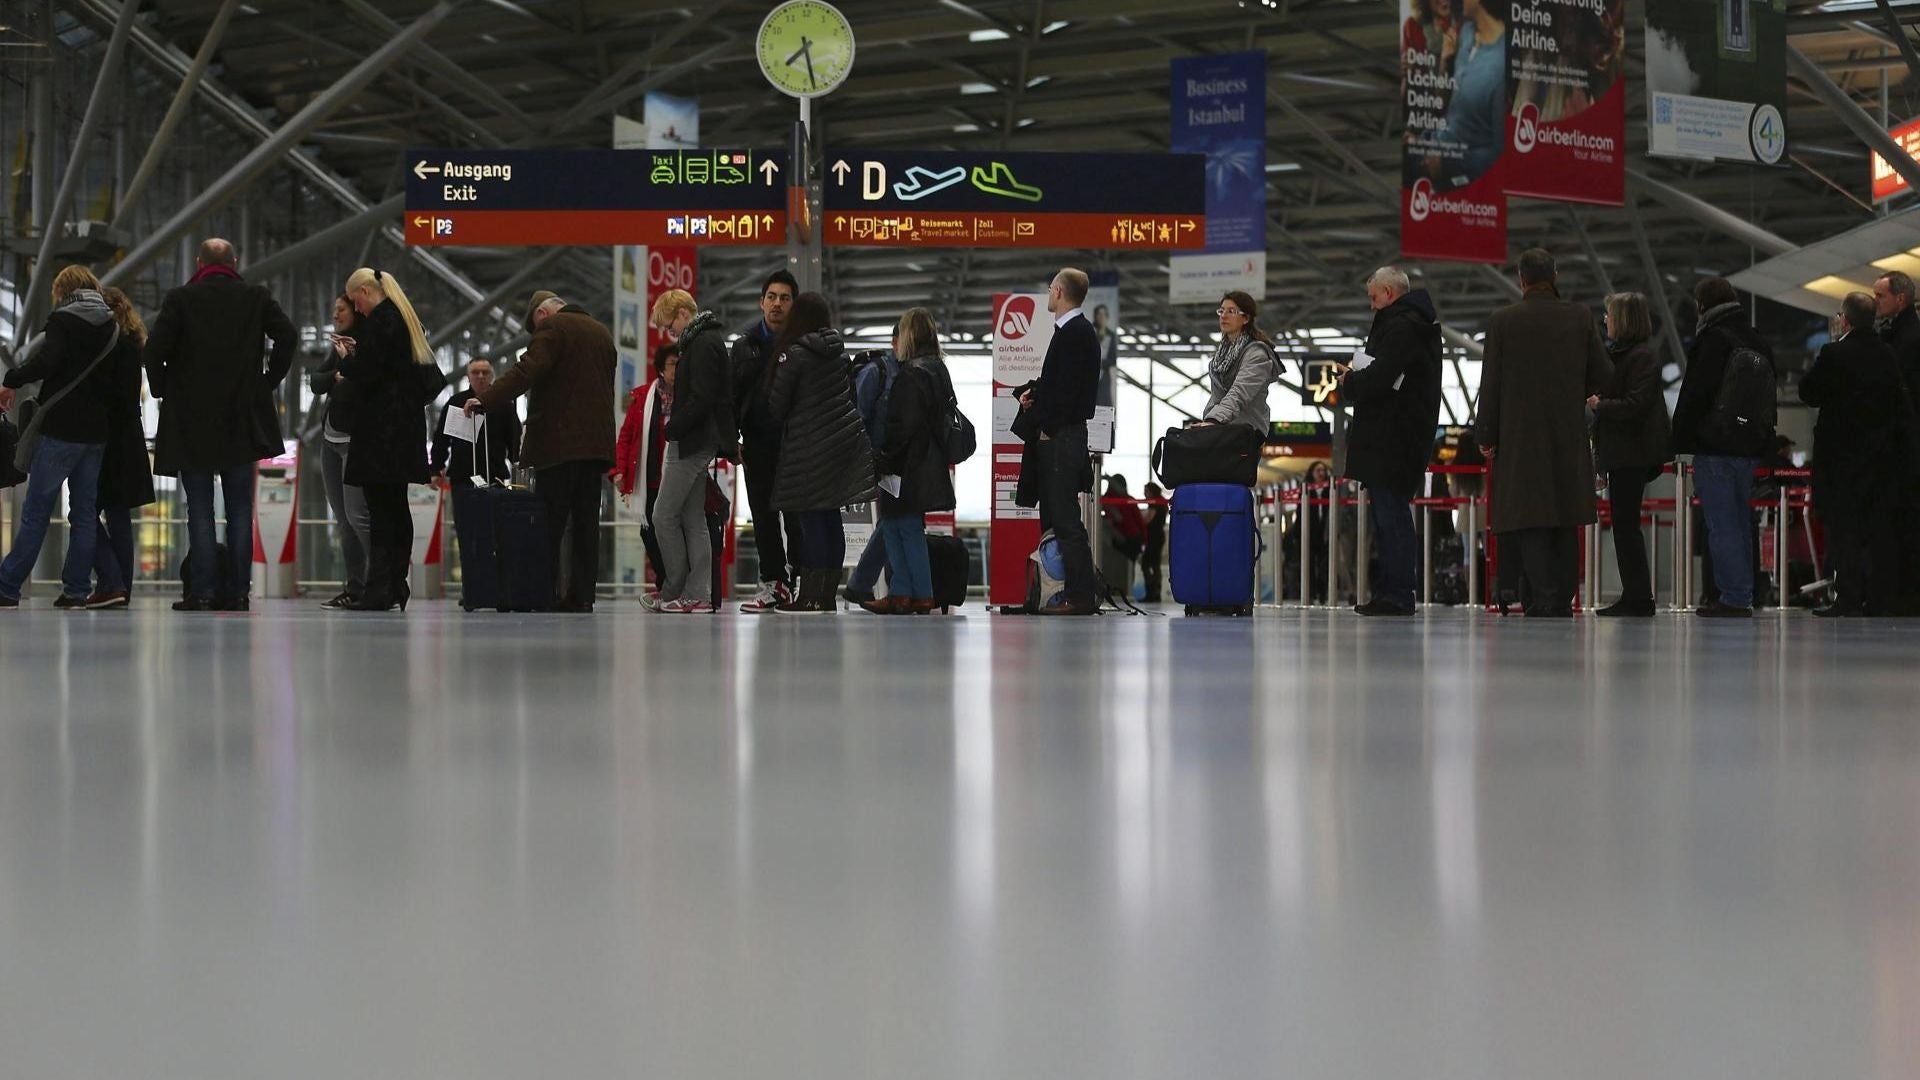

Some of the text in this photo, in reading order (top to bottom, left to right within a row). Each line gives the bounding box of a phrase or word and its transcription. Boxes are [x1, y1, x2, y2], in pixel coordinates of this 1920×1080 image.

[1511, 3, 1552, 27] Deine
[1511, 27, 1559, 53] Airline.
[1407, 47, 1436, 67] Dein
[1187, 78, 1248, 97] Business
[1407, 89, 1444, 110] Deine
[1188, 103, 1245, 126] Istanbul
[1407, 110, 1450, 131] Airline.
[1537, 125, 1614, 152] airberlin.com
[652, 155, 673, 165] Taxi
[443, 161, 512, 181] Ausgang
[863, 161, 887, 200] D
[443, 184, 477, 201] Exit
[1430, 198, 1498, 217] airberlin.com
[436, 219, 453, 234] P2
[667, 218, 684, 234] PN
[920, 219, 963, 228] Reisemarkt
[979, 219, 994, 228] Zoll
[1117, 219, 1129, 228] WC
[1140, 221, 1152, 231] WC
[921, 228, 969, 237] Travel market
[648, 254, 693, 290] Oslo
[998, 344, 1034, 352] airberlin
[1010, 364, 1042, 372] destinatio
[994, 472, 1020, 481] Premiu
[847, 536, 869, 544] Recht
